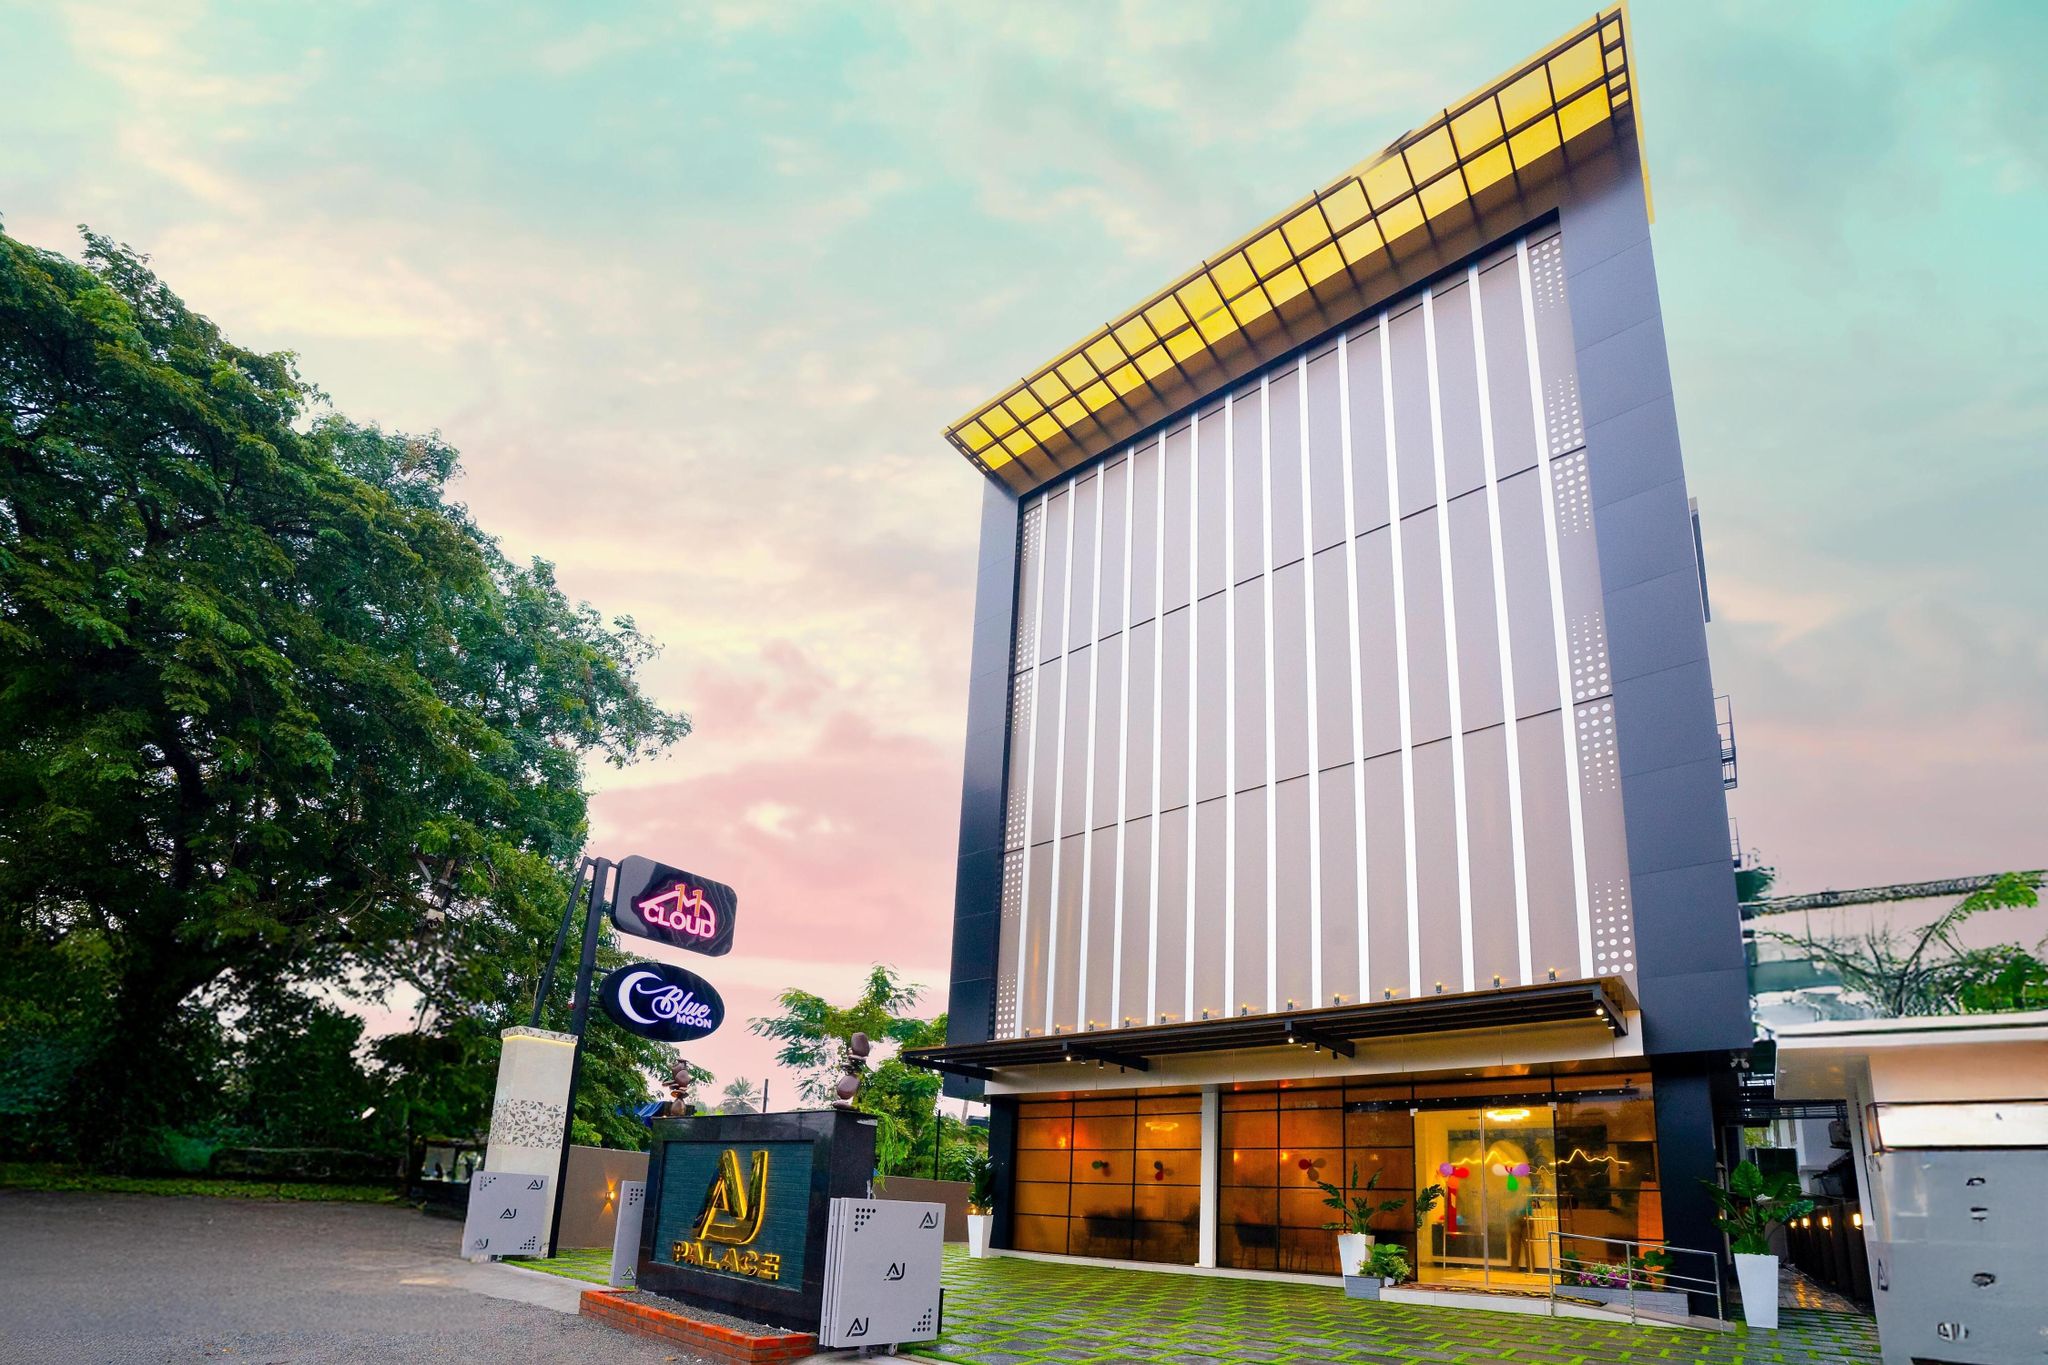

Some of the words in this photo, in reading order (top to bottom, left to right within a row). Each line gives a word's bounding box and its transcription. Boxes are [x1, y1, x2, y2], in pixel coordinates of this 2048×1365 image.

[643, 904, 716, 938] CLOUD
[636, 984, 711, 1019] Blue
[676, 1013, 712, 1029] MOON
[527, 1180, 544, 1190] AJ
[692, 1149, 769, 1245] AJ
[500, 1208, 517, 1219] AJ
[919, 1211, 939, 1229] AJ
[672, 1240, 781, 1281] PALACE
[883, 1262, 906, 1281] AJ
[845, 1317, 869, 1337] AJ
